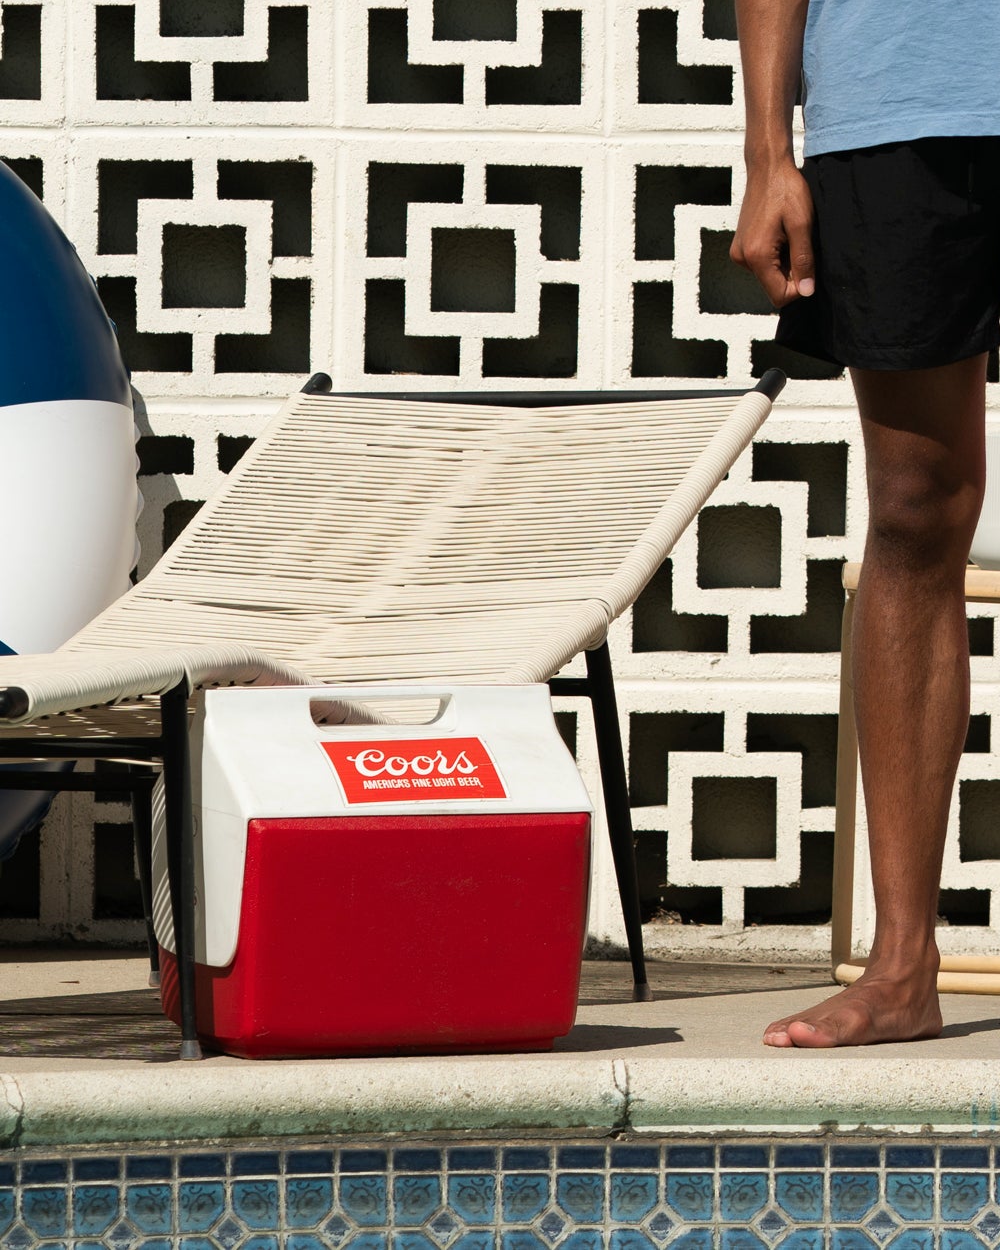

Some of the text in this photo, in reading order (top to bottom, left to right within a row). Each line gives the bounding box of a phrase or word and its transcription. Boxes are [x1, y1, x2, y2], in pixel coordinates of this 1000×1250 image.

[346, 749, 479, 777] Coors
[363, 779, 411, 790] AMERICA'S
[412, 778, 432, 788] FINE
[433, 777, 457, 788] LIGHT
